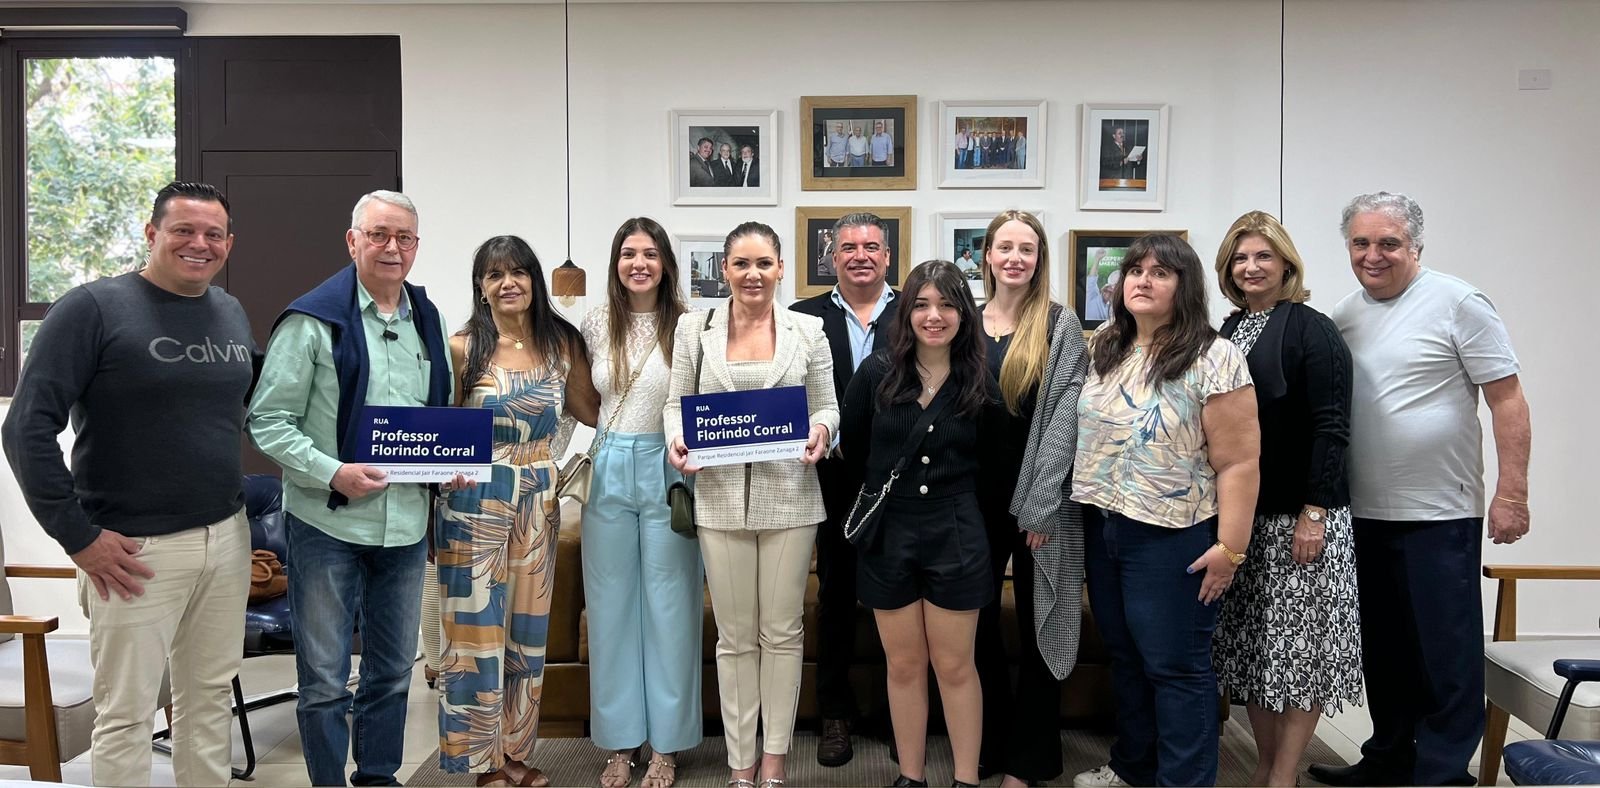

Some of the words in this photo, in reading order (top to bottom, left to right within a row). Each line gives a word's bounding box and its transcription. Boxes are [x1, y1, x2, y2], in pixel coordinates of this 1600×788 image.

[148, 336, 251, 363] Calvin
[696, 414, 757, 428] Professor
[372, 430, 439, 442] Professor
[697, 427, 751, 442] Florindo
[753, 422, 793, 437] Corral
[371, 444, 430, 456] Florindo
[433, 445, 475, 457] Corral
